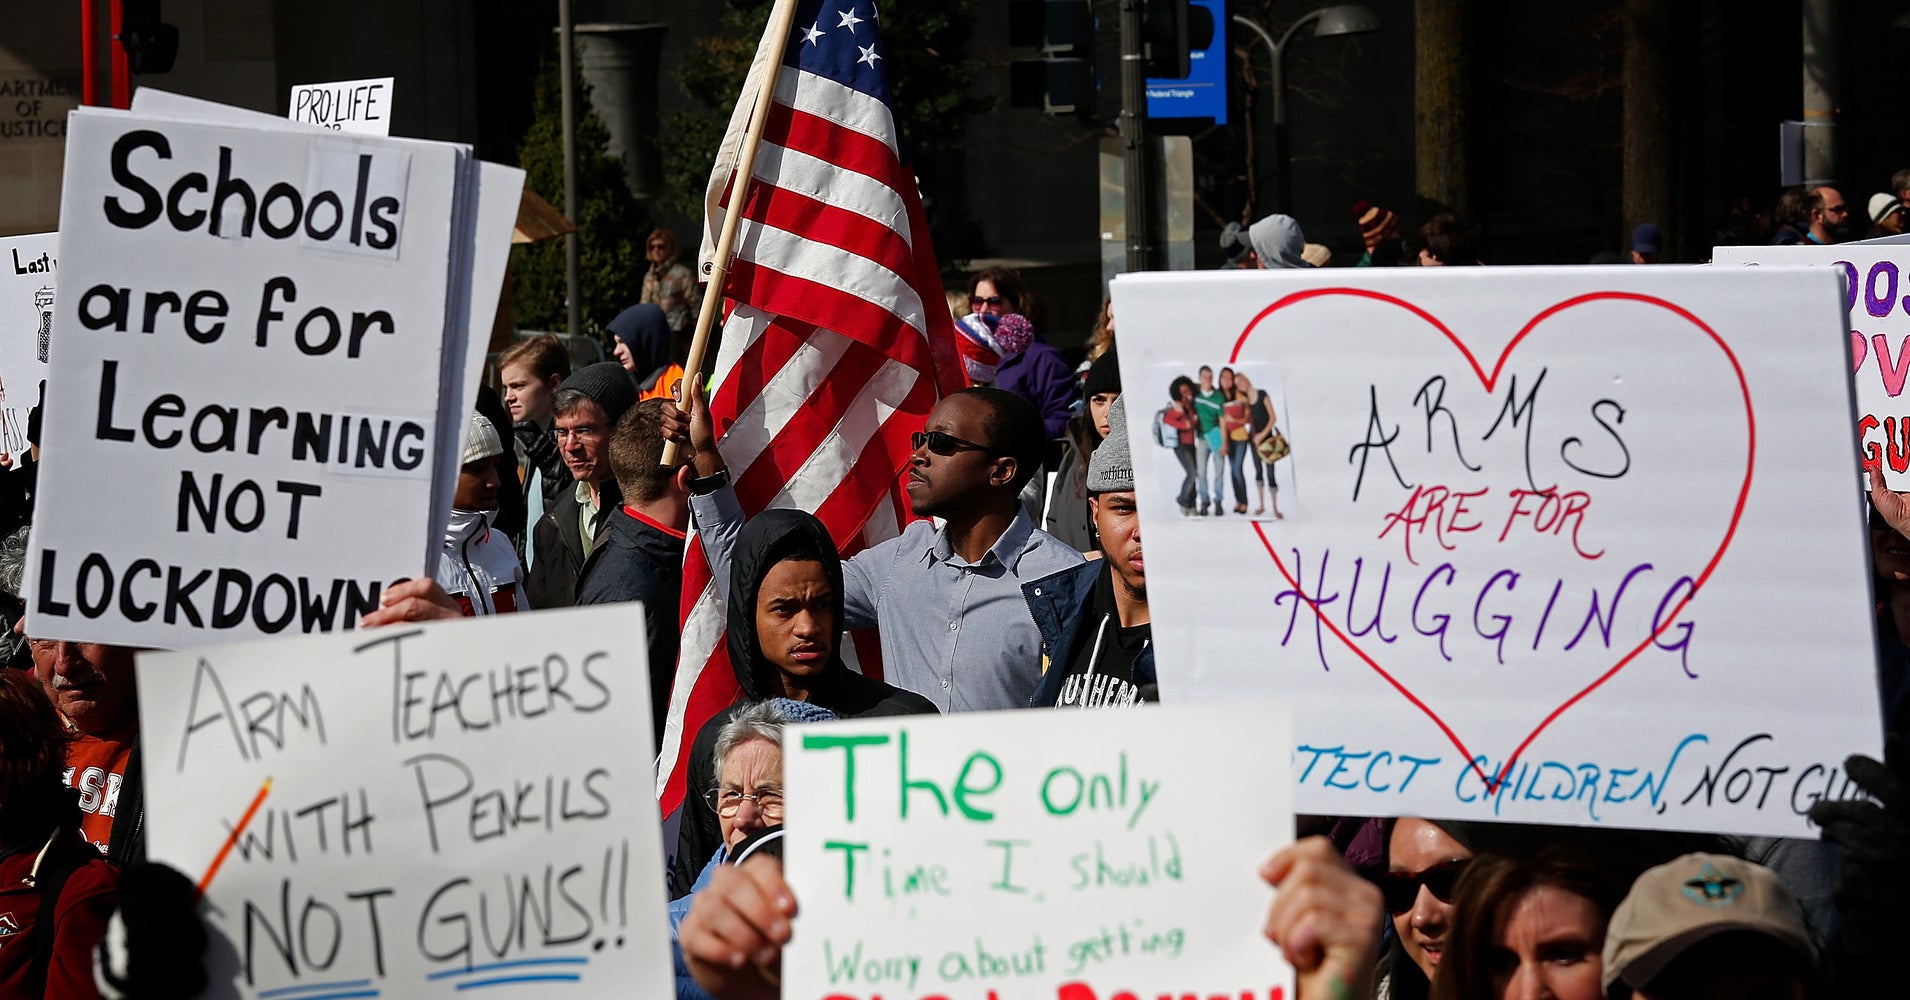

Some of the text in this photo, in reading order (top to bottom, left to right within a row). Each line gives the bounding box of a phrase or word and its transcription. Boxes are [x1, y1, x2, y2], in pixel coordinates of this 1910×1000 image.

[16, 100, 42, 117] OF
[104, 129, 400, 250] Schools
[11, 248, 50, 275] Last
[78, 277, 395, 358] are for
[1349, 366, 1630, 501] ARMS
[177, 471, 321, 539] NOT
[1379, 484, 1604, 565] ARE FOR
[38, 549, 412, 634] LOCKDOWN
[1274, 547, 1699, 679] HUGGING
[177, 629, 611, 774] ARM TEACHERS
[222, 752, 613, 863] WITH PENCILS
[802, 729, 1159, 828] The only
[1292, 745, 1441, 793] TECT
[1680, 733, 1789, 810] NOT
[823, 840, 950, 902] Time
[1071, 832, 1184, 891] should
[243, 838, 630, 987] NOT GUNS!!
[938, 937, 1046, 982] about
[1064, 920, 1185, 976] getting
